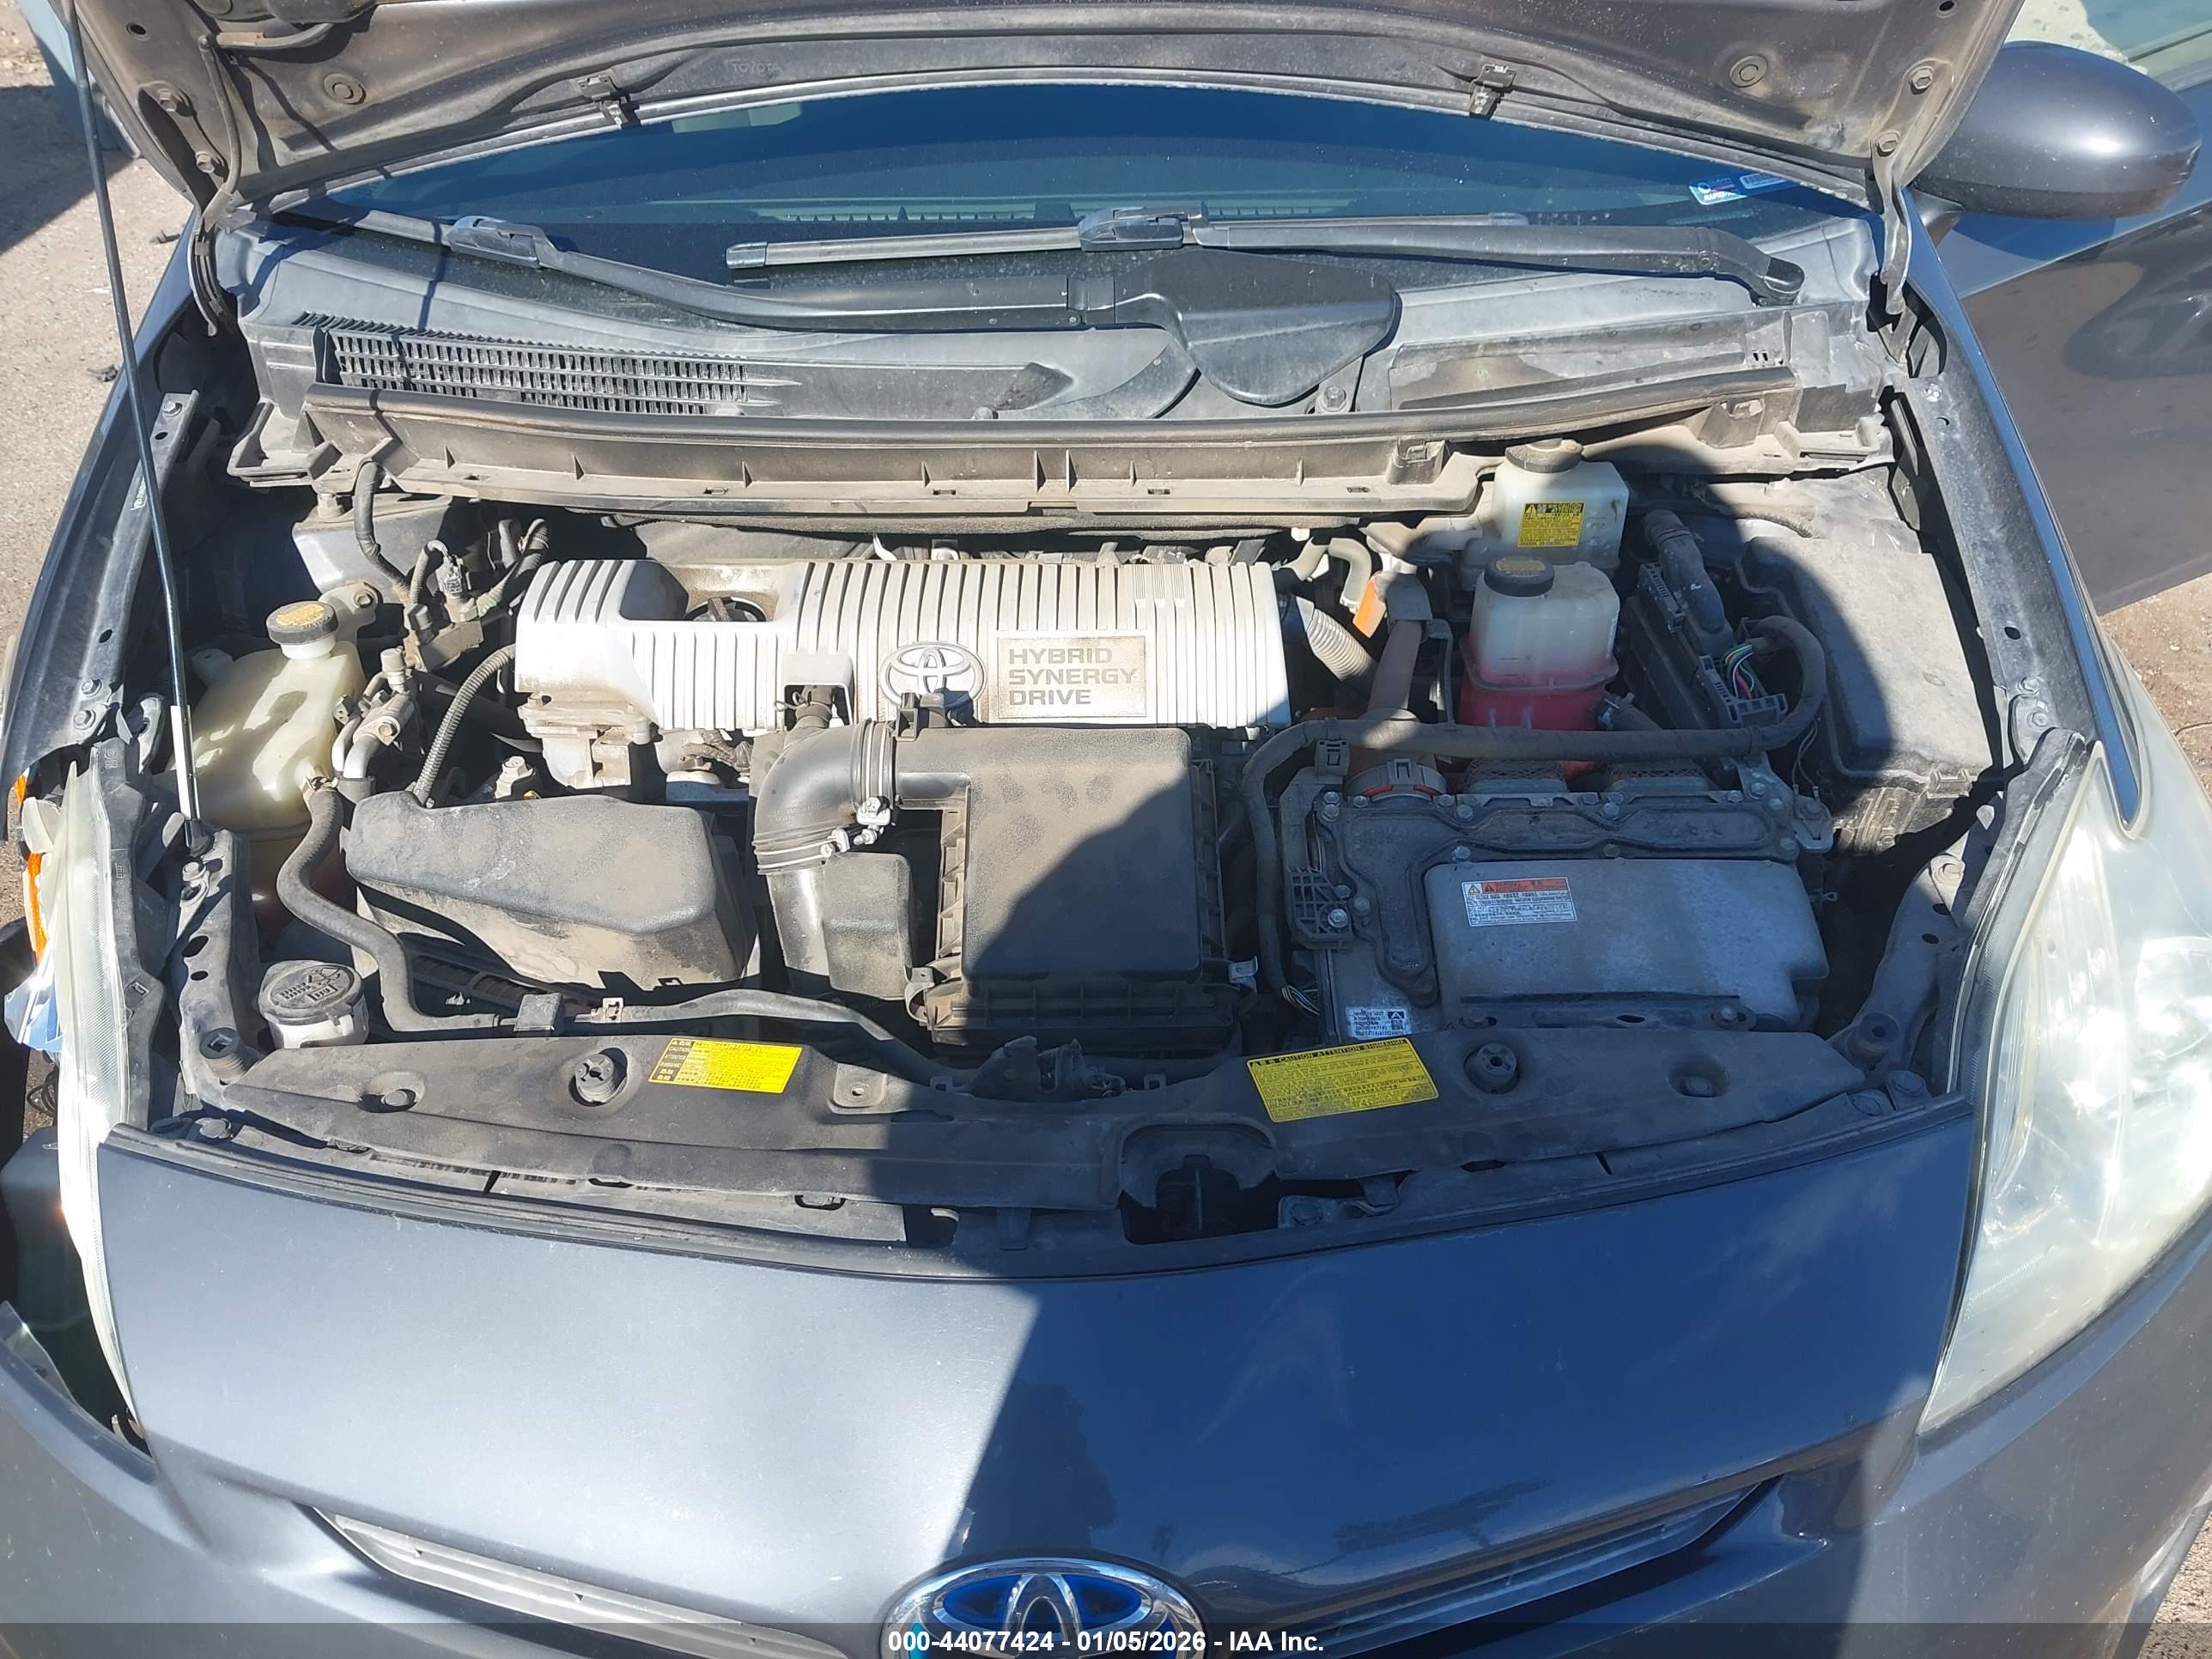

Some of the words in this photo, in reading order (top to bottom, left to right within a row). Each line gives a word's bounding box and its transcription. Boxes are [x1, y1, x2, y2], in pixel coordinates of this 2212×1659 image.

[1009, 647, 1112, 665] HYBRID
[1009, 668, 1138, 685] SYNERGY
[1009, 689, 1091, 706] DRIVE
[1280, 1053, 1314, 1062] CAUTION
[1317, 1046, 1361, 1057] ATTENTION
